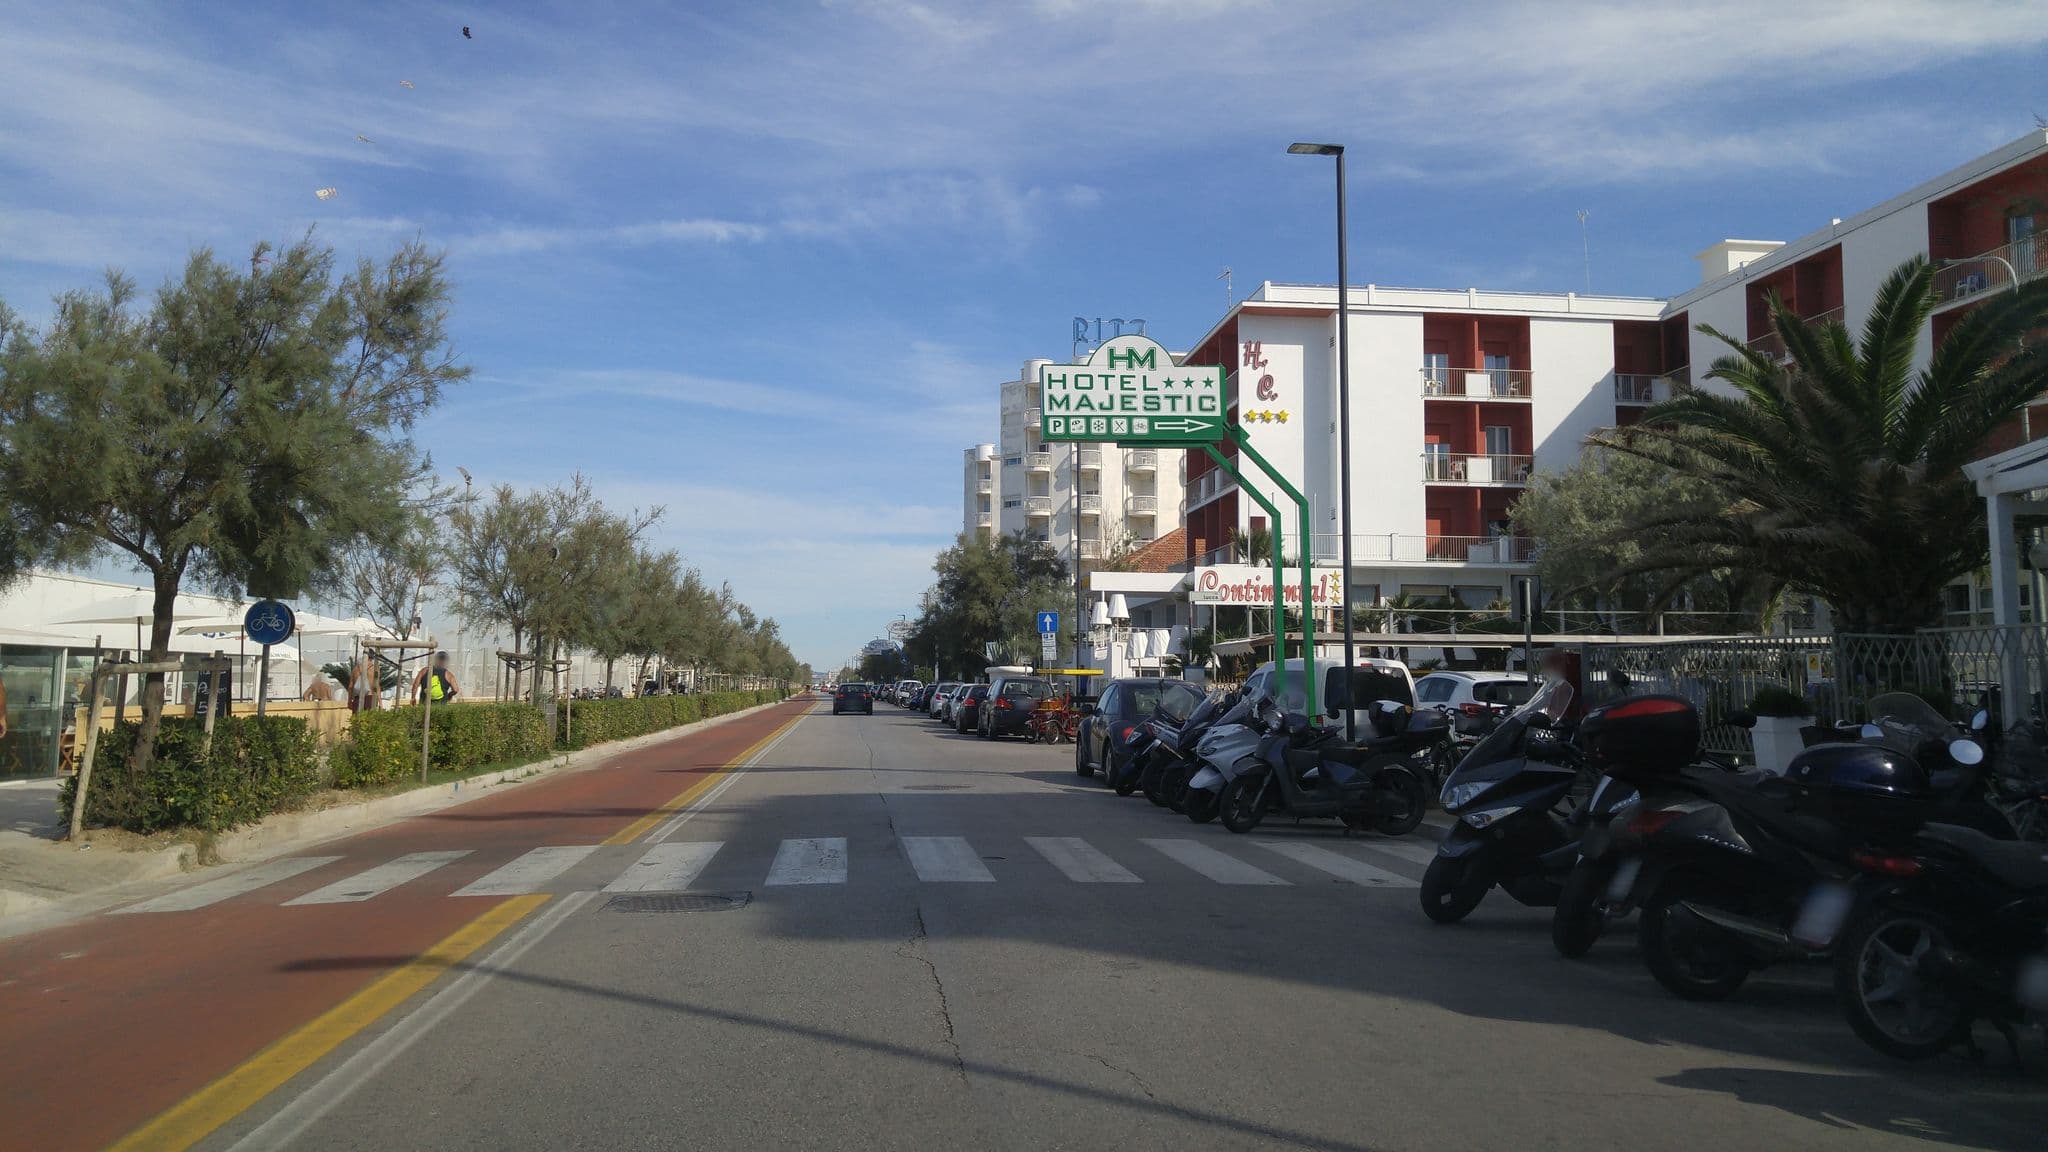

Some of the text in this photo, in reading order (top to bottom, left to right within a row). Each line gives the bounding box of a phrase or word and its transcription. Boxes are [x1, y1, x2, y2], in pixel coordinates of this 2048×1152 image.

[1107, 347, 1156, 371] HM
[1047, 373, 1158, 391] HOTEL
[1048, 394, 1216, 412] MAJESTIC
